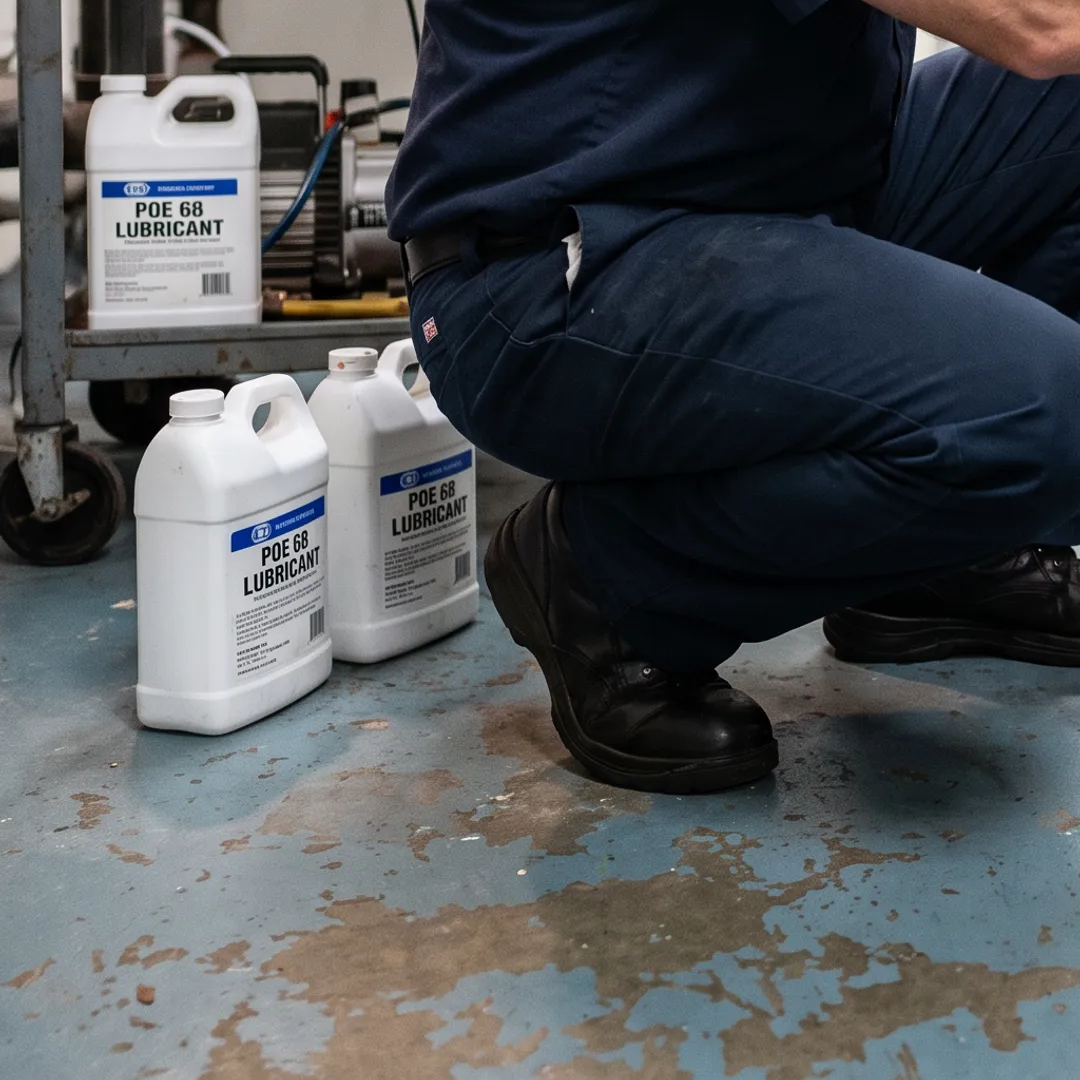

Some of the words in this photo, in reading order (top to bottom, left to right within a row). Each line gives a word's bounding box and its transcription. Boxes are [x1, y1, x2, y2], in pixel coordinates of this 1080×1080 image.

[135, 201, 173, 218] POE
[179, 200, 204, 218] 68
[116, 219, 224, 238] LUBRICANT
[408, 486, 437, 511] POE
[392, 495, 468, 537] LUBRICANT
[261, 537, 290, 566] POE
[243, 545, 320, 597] LUBRICANT
